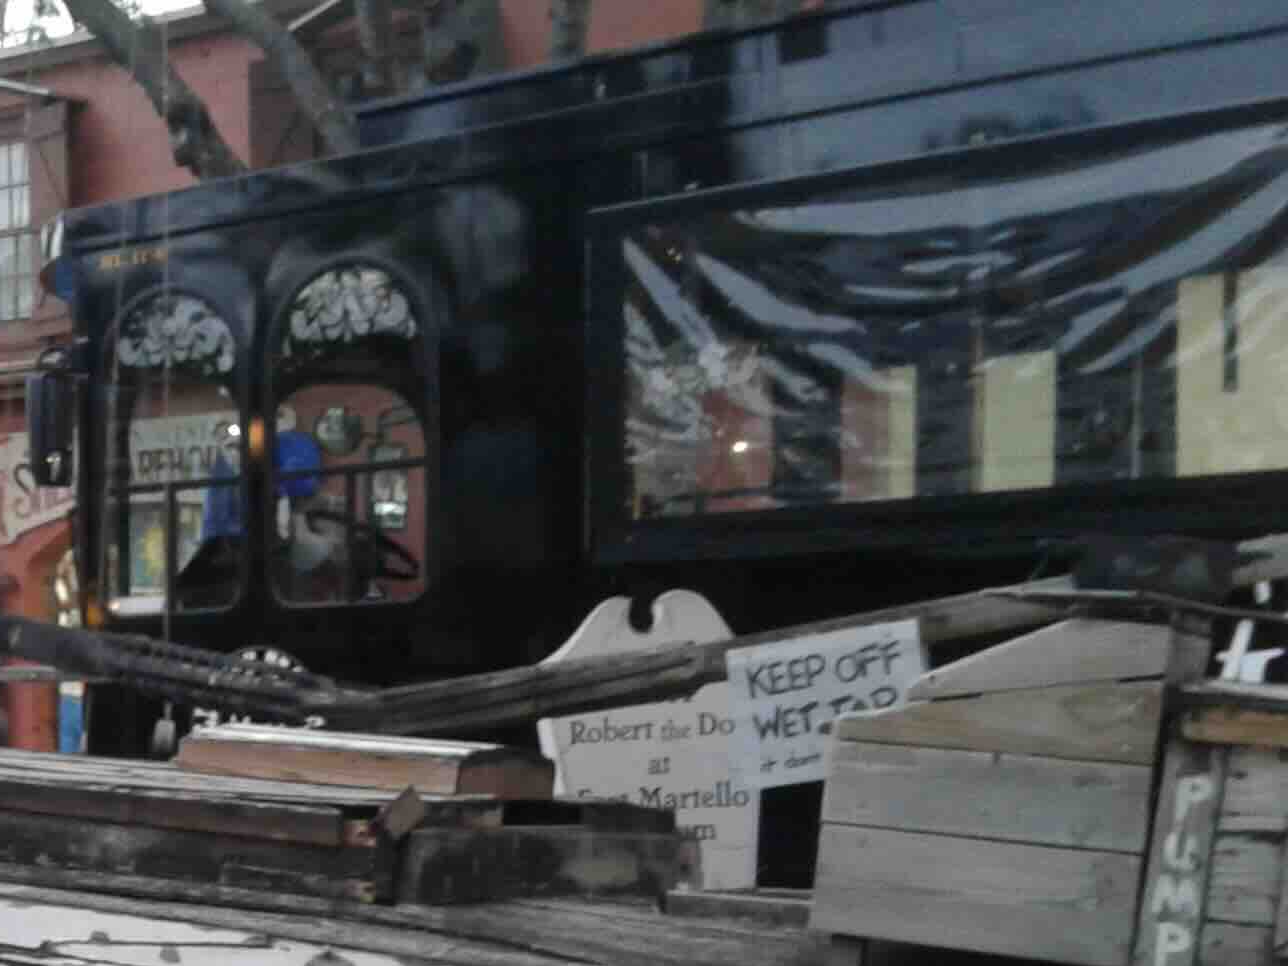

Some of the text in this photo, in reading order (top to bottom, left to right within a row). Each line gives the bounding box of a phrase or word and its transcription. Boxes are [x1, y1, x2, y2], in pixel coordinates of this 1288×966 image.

[747, 639, 901, 698] KEEP OFF
[569, 717, 655, 744] Robert
[753, 701, 818, 739] WET
[639, 779, 751, 809] Martello
